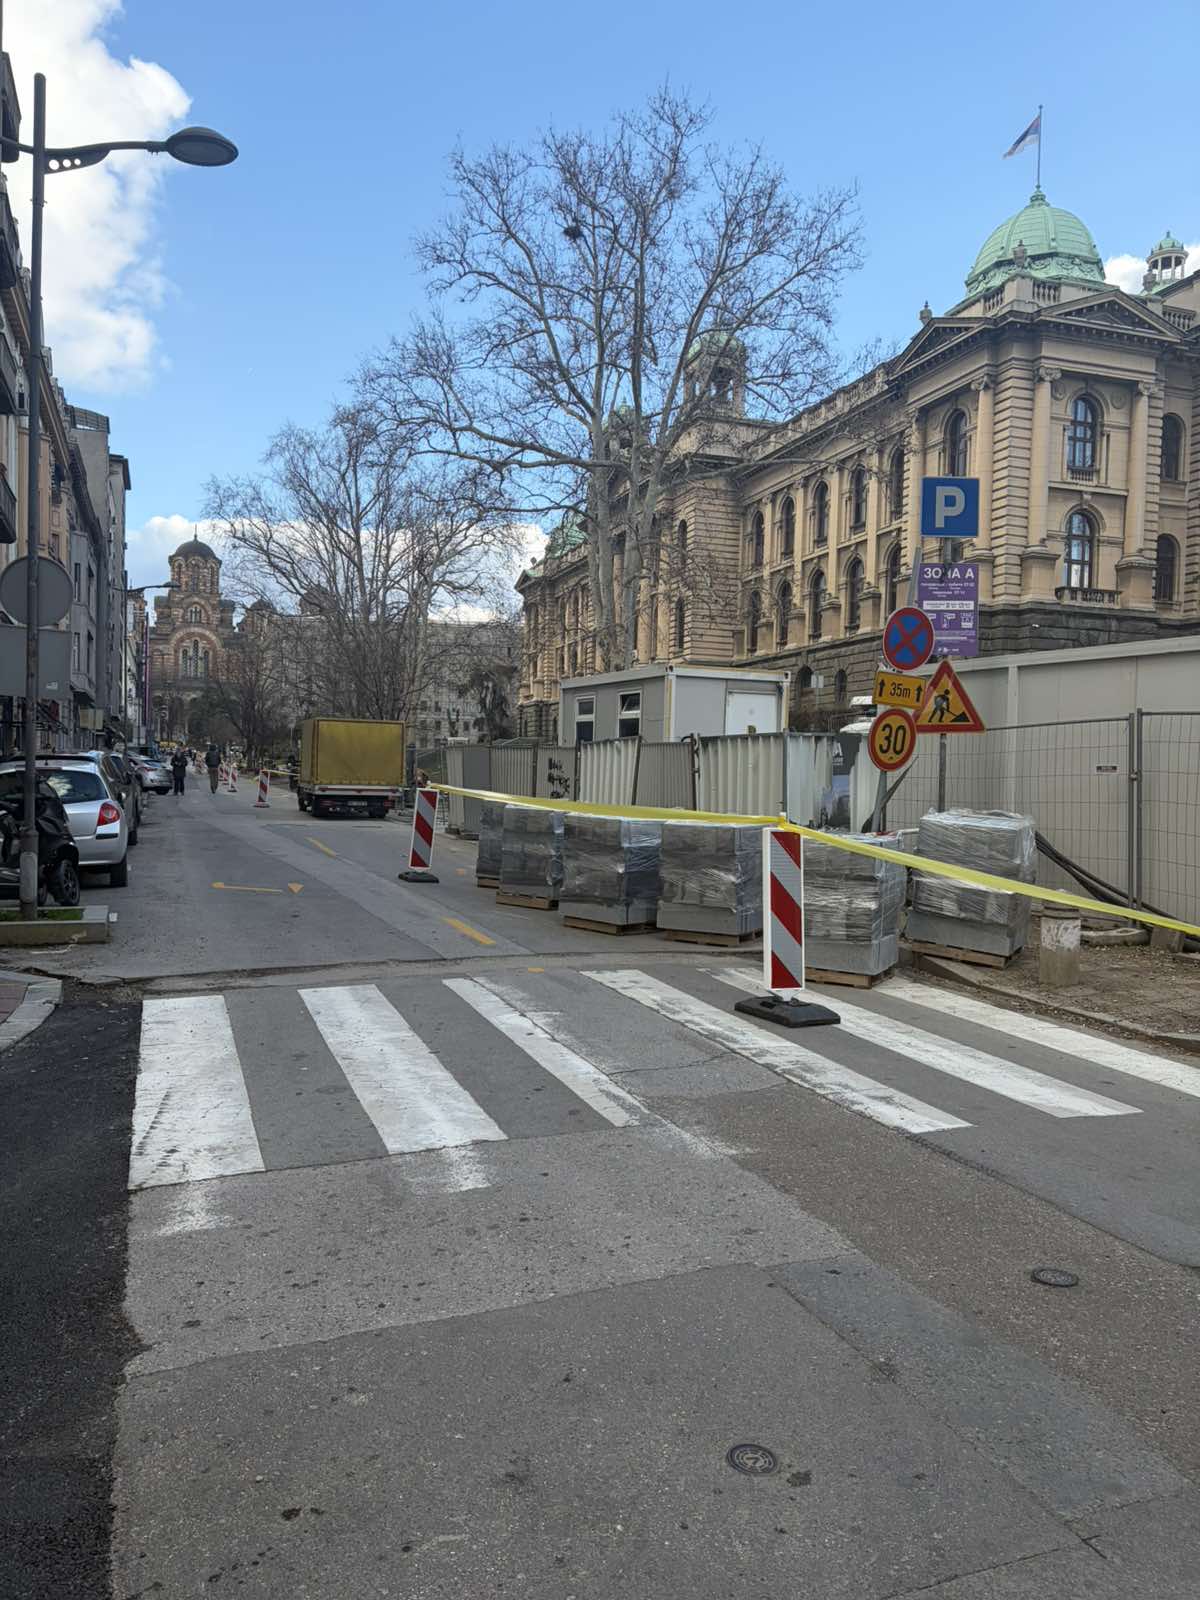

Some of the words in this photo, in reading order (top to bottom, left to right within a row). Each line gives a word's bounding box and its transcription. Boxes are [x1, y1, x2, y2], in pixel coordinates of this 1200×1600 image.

[935, 486, 966, 528] P
[965, 567, 975, 579] А
[889, 682, 911, 699] 35m
[879, 723, 907, 755] 30
